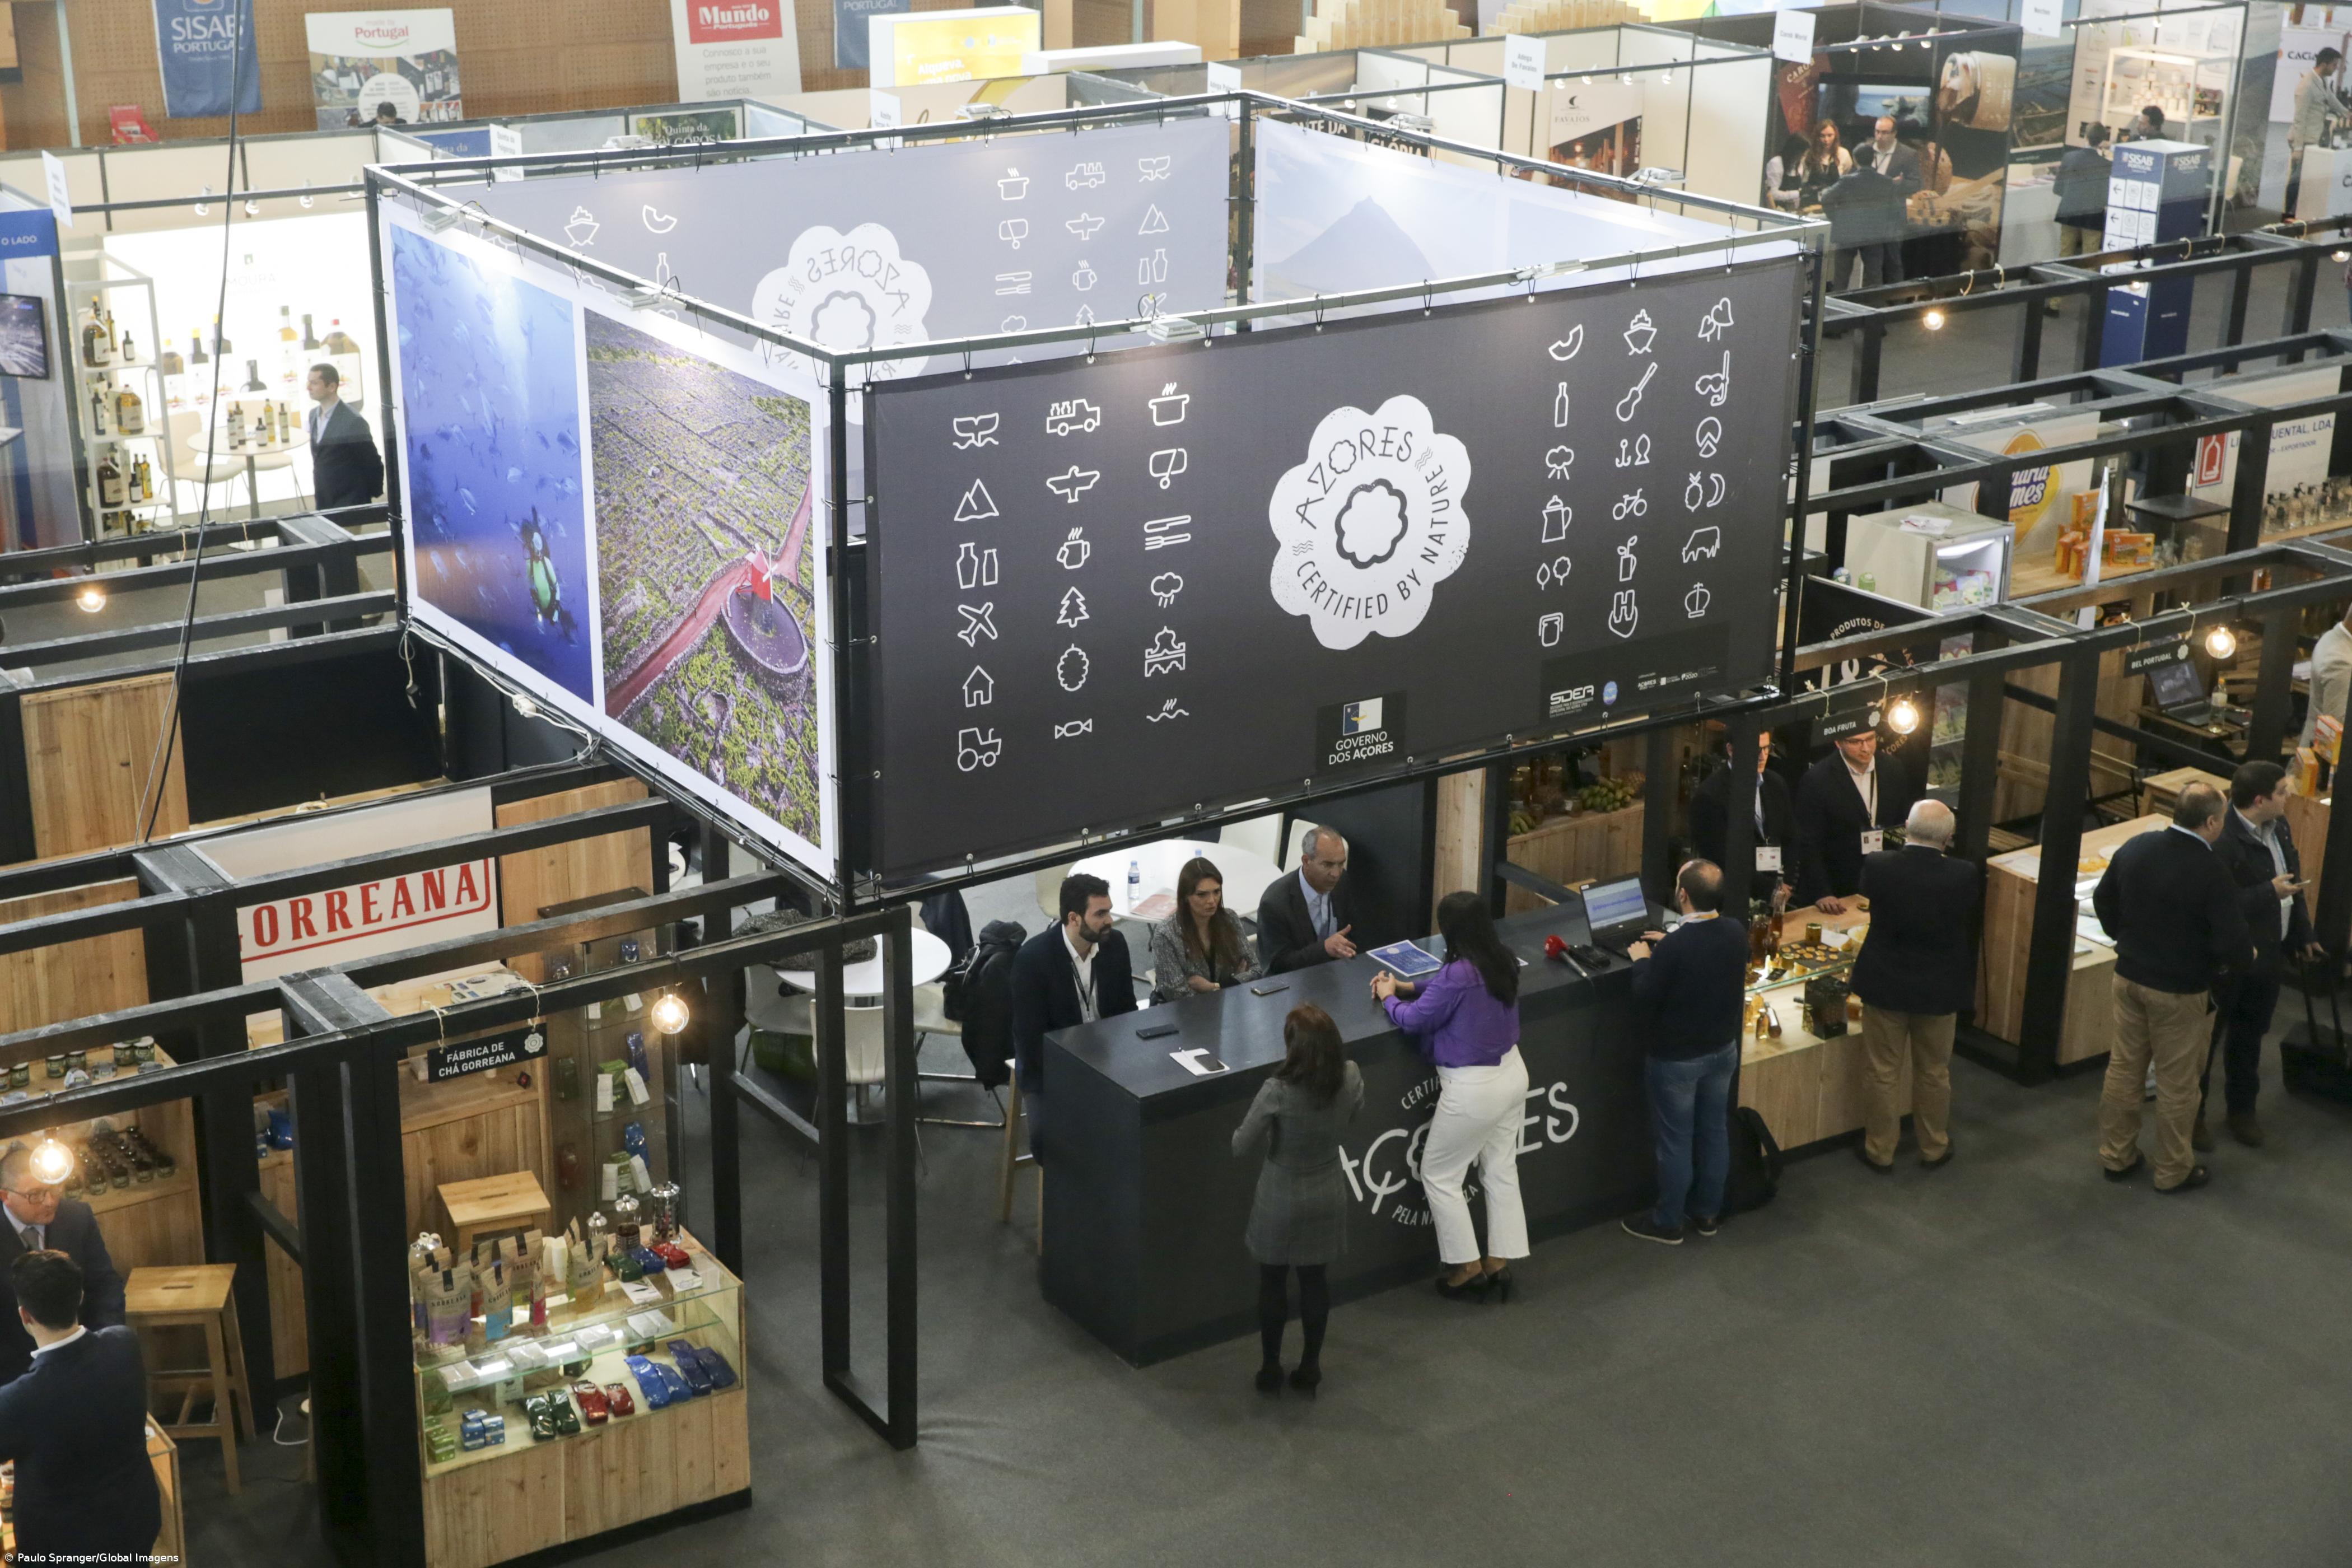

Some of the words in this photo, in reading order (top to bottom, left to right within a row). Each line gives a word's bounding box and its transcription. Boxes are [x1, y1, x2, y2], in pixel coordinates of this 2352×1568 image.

[699, 4, 769, 25] Mundo
[171, 15, 246, 41] SISAB
[355, 26, 409, 40] Portugal
[704, 62, 739, 71] empresa
[706, 75, 736, 85] produto
[665, 124, 695, 136] Quinta
[2129, 153, 2154, 166] SISAB
[11, 235, 38, 245] LADO
[2271, 423, 2311, 440] UENTAL,
[1296, 427, 1412, 529] AZORES
[1420, 465, 1450, 564] NATURE
[1297, 561, 1388, 619] CERTIFIED
[1397, 568, 1421, 600] BY
[1830, 618, 1872, 641] PRODUTOS
[2131, 660, 2143, 669] BEL
[2143, 652, 2172, 666] PORTUGAL
[1550, 685, 1594, 705] SDEA
[1824, 726, 1836, 736] BOA
[1837, 721, 1856, 733] FRUTA
[1336, 731, 1388, 751] GOVERNO
[1329, 751, 1351, 765] DOS
[1352, 741, 1394, 760] AÇORES
[240, 863, 479, 950] ORREANA
[446, 1045, 489, 1063] FÁBRICA
[491, 1042, 505, 1053] DE
[438, 1062, 460, 1077] CHÁ
[461, 1052, 516, 1072] GORREANA
[1392, 1205, 1417, 1226] PELA
